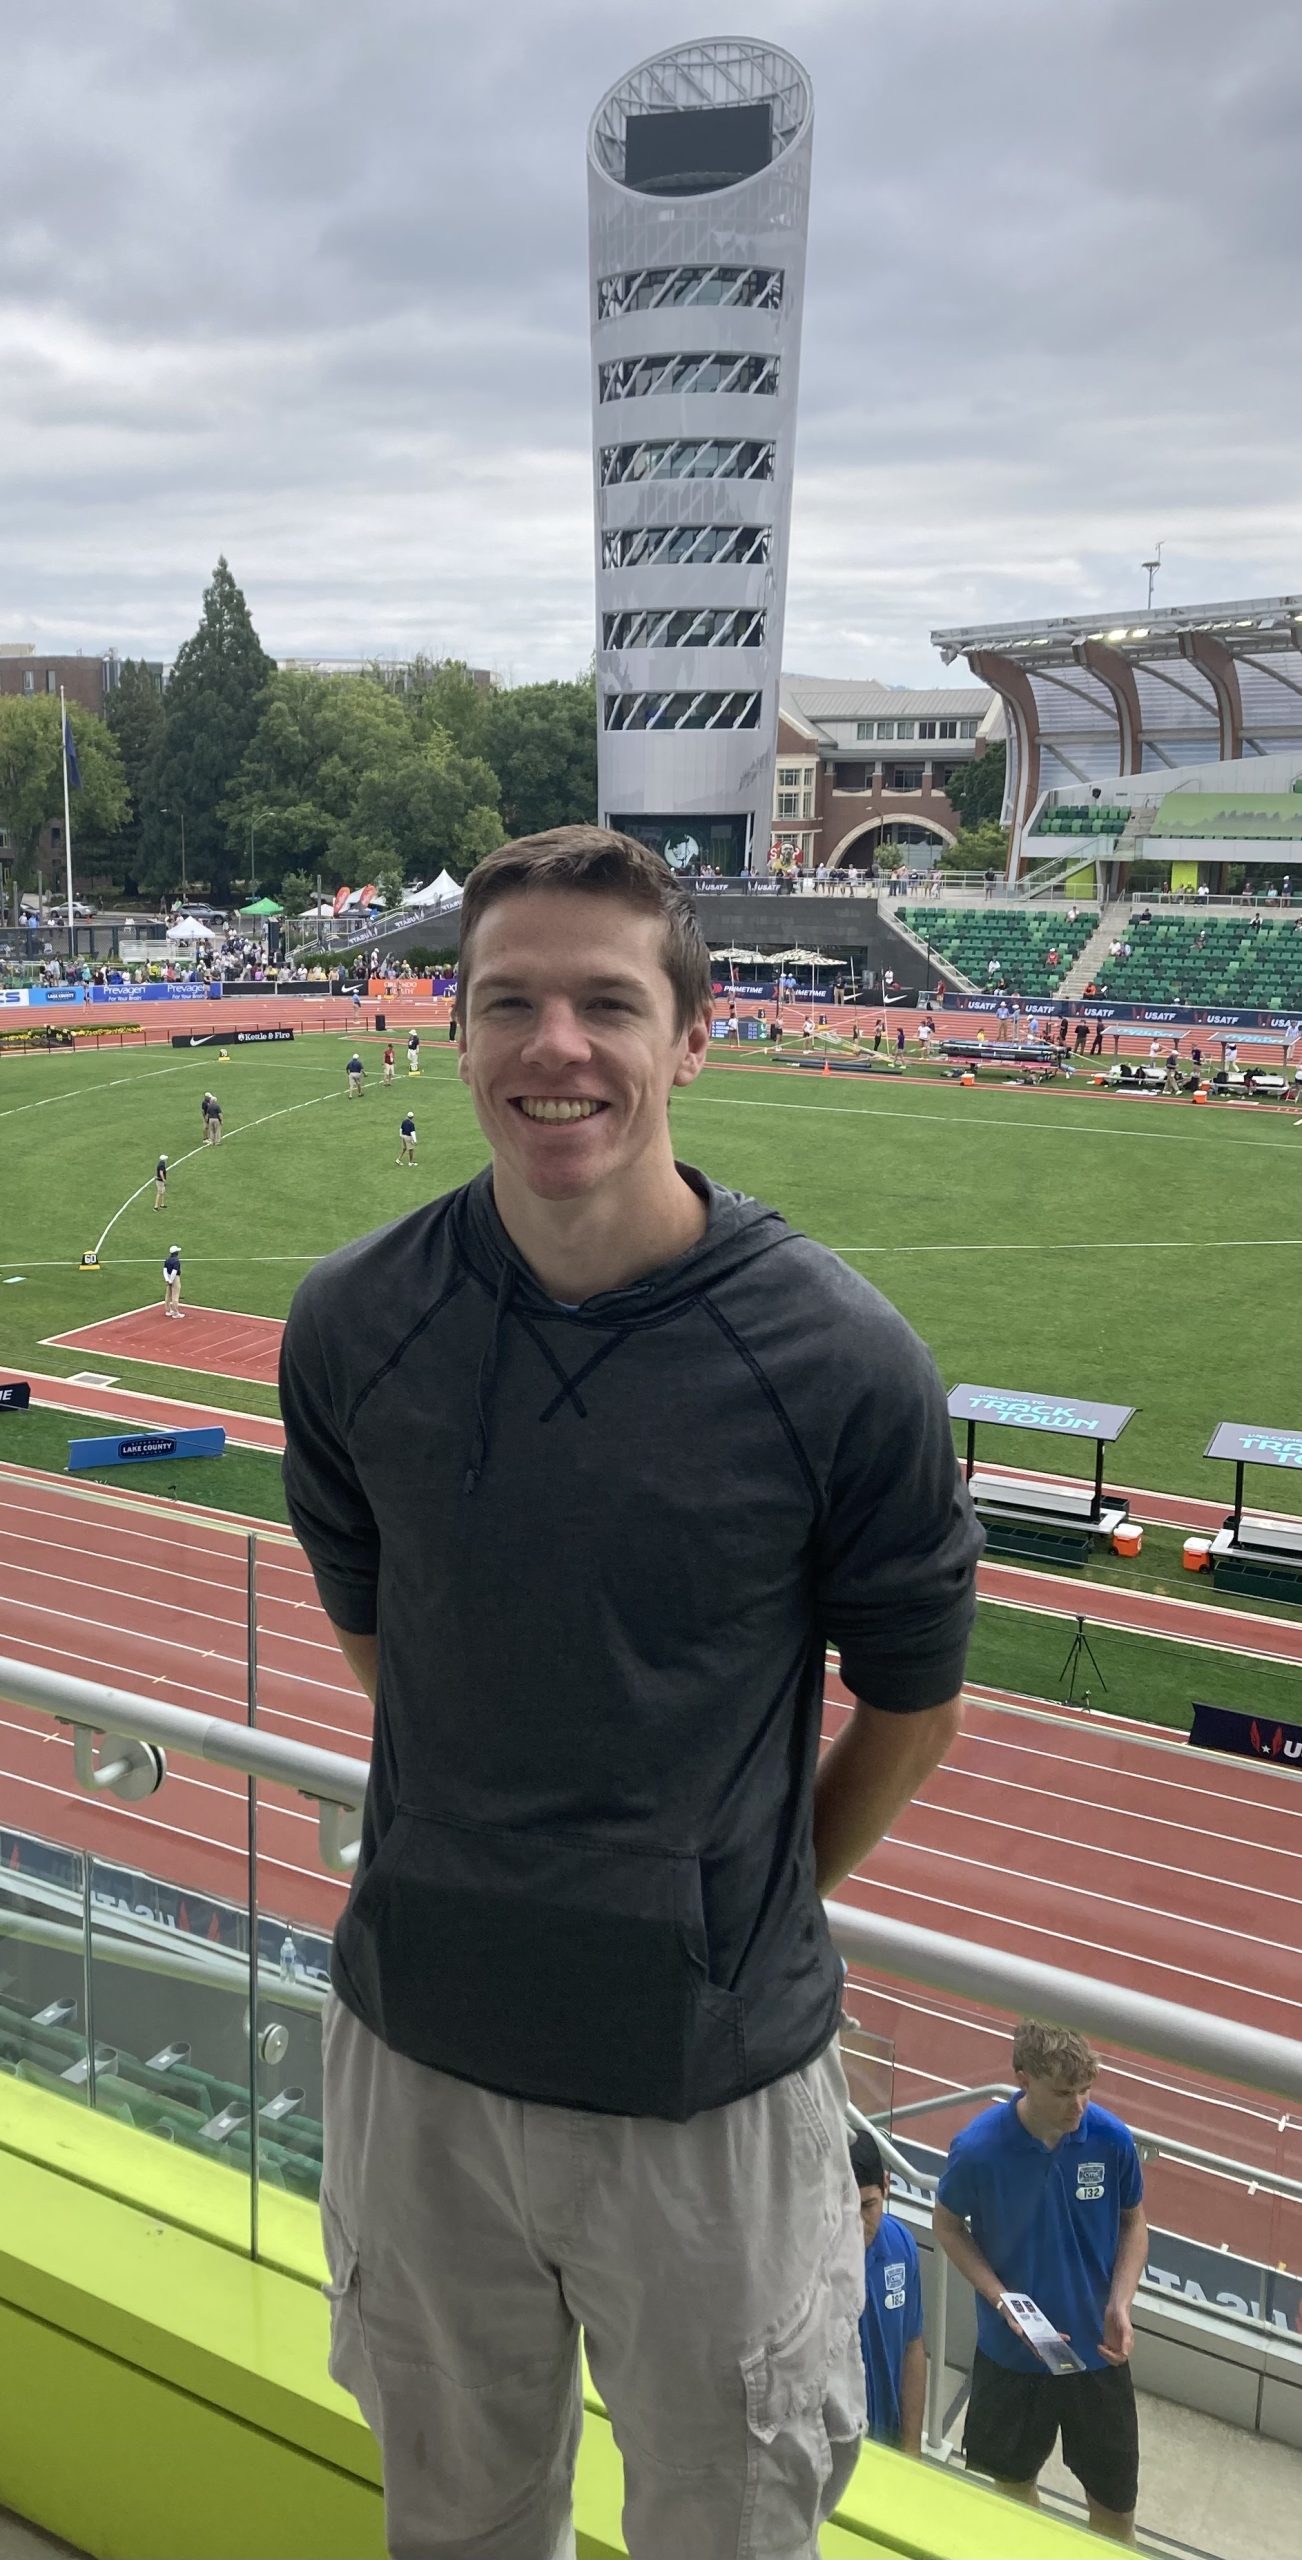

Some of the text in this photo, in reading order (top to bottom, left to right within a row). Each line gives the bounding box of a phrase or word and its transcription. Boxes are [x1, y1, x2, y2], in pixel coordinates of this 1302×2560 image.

[103, 986, 146, 995] Prevagen
[167, 984, 205, 993] Prevage
[723, 985, 763, 994] PRIMETIME
[967, 1001, 997, 1011] USATF
[1025, 1004, 1055, 1014] USATF
[1084, 1008, 1115, 1018] USATF
[1144, 1012, 1177, 1021] USATF
[1207, 1015, 1240, 1024] USATF
[245, 1032, 267, 1041] Kettle
[84, 1255, 97, 1263] 60
[0, 1390, 13, 1401] E
[968, 1398, 1078, 1417] TRACK
[996, 1411, 1099, 1430] TOWN
[143, 1443, 172, 1451] COUNTY
[1084, 2188, 1100, 2198] 132
[892, 2293, 903, 2306] 182
